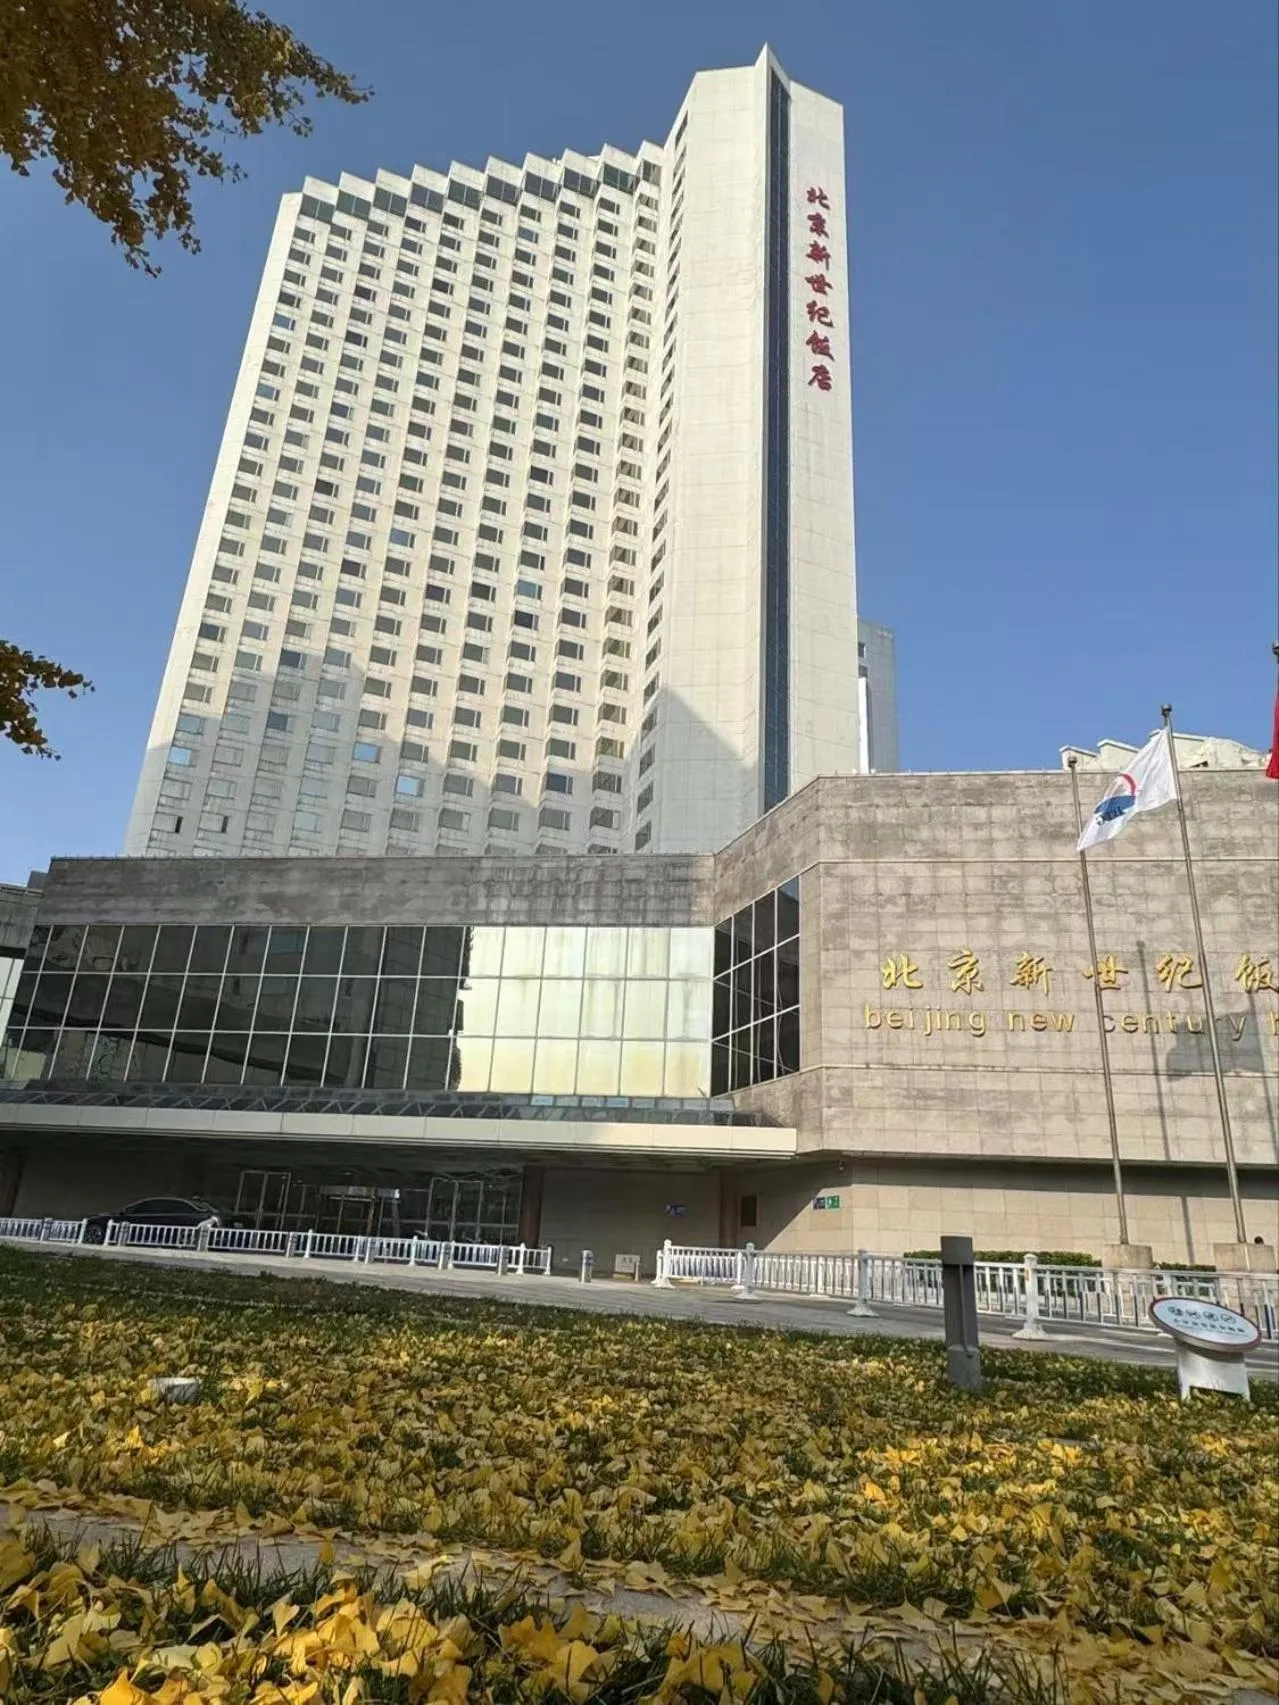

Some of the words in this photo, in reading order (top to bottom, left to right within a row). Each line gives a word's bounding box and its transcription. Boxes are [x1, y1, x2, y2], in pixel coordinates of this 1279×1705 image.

[804, 186, 835, 392] 北京新世纪饭店
[864, 1005, 986, 1038] beijing
[1007, 1012, 1076, 1032] new
